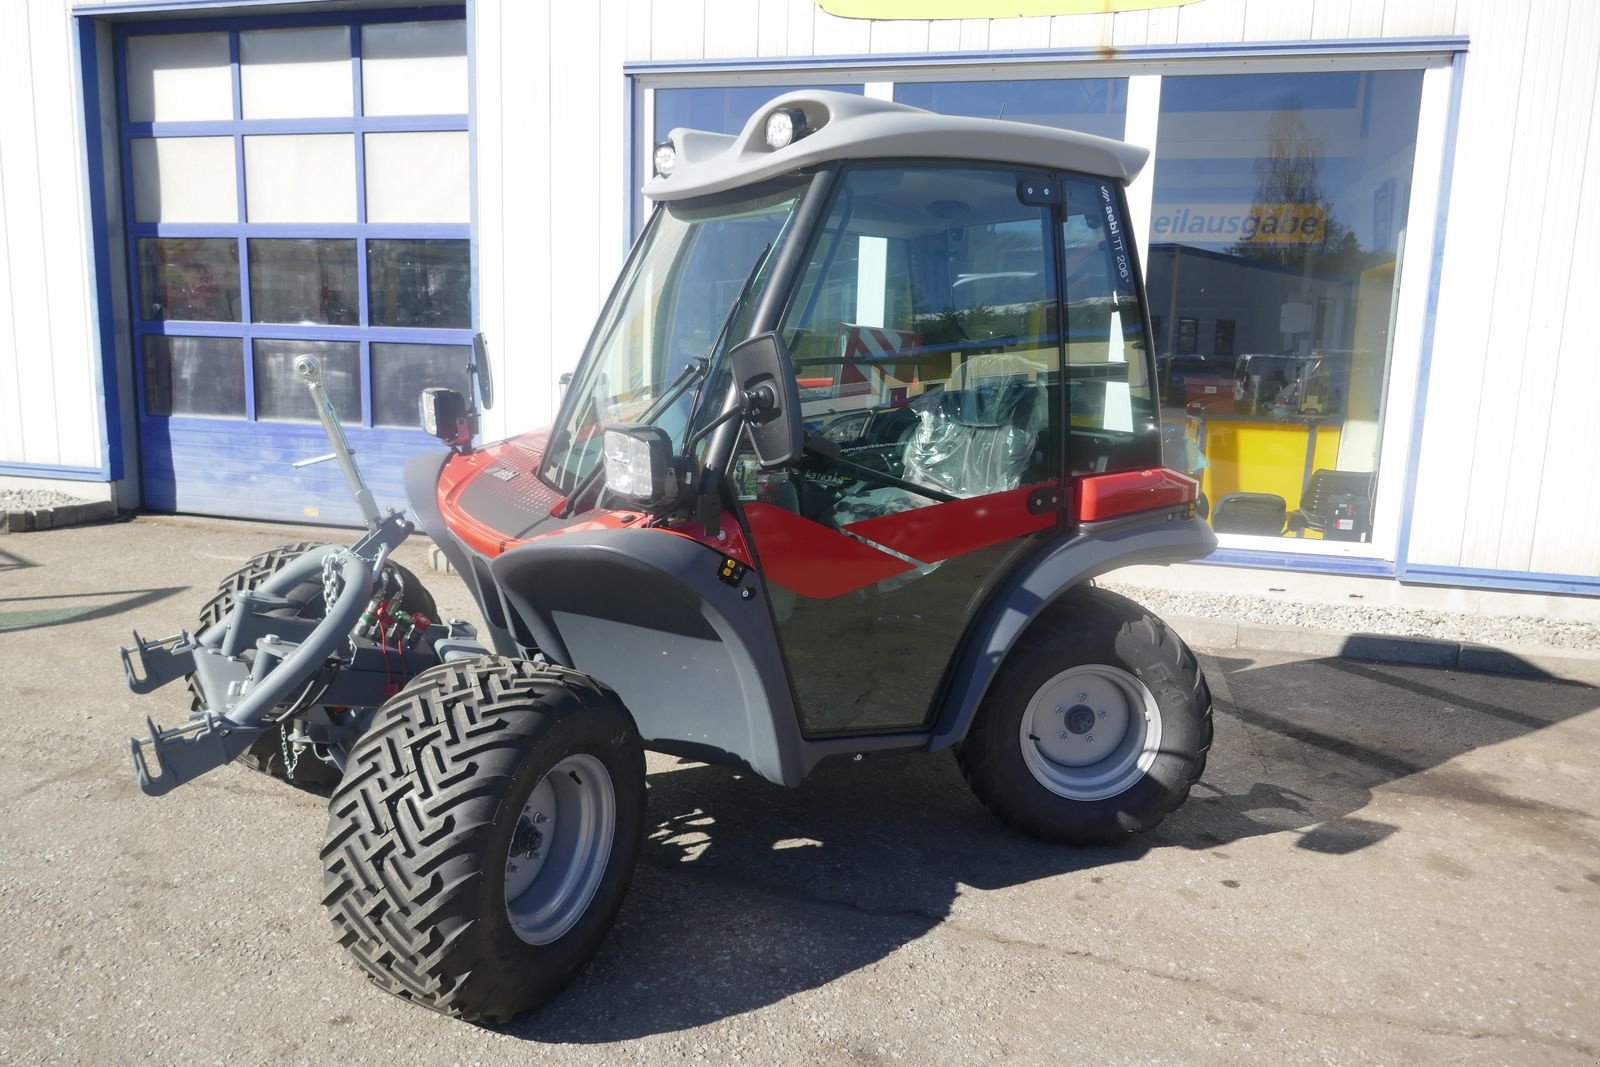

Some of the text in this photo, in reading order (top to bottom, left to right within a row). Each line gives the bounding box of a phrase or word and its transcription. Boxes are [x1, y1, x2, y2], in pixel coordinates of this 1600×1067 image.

[1106, 206, 1120, 235] aebi
[1113, 236, 1124, 252] TT
[1152, 207, 1320, 241] eilausgabe
